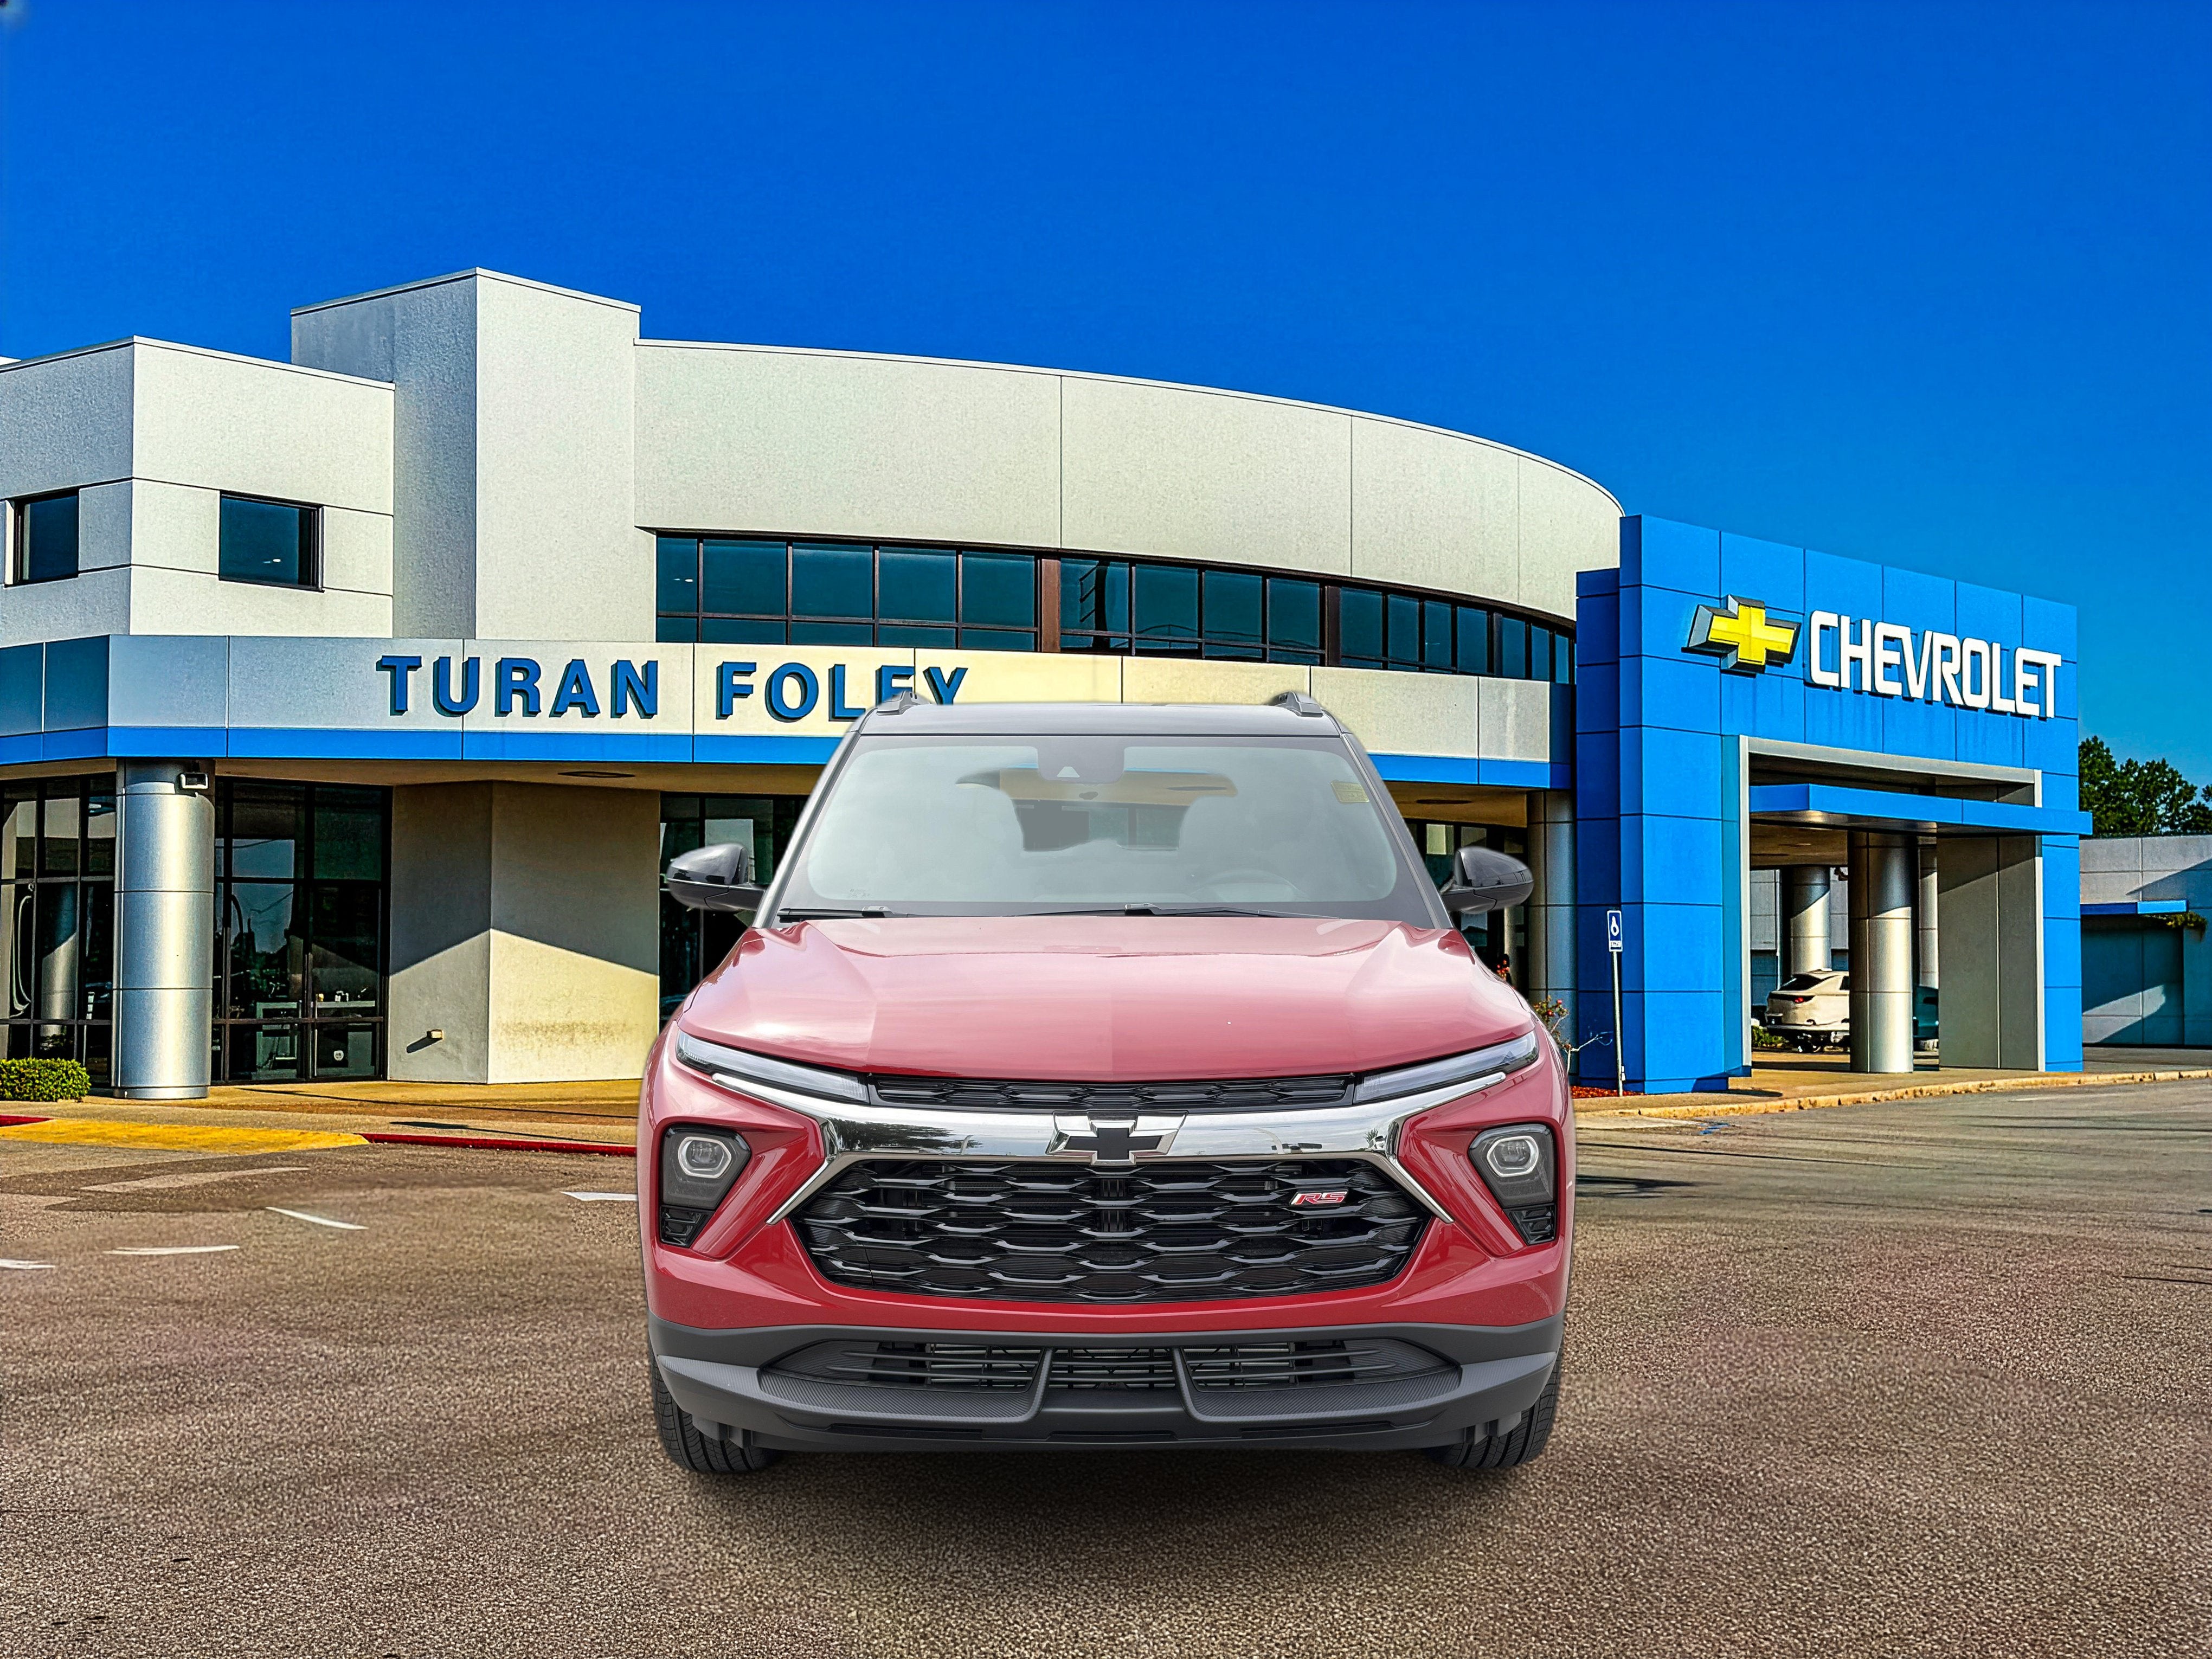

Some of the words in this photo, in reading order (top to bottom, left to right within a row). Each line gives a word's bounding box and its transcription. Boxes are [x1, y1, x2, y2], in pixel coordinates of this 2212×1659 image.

[376, 654, 659, 719] TURAN
[1810, 610, 2062, 718] CHEVROLET
[1290, 1191, 1348, 1205] RS
